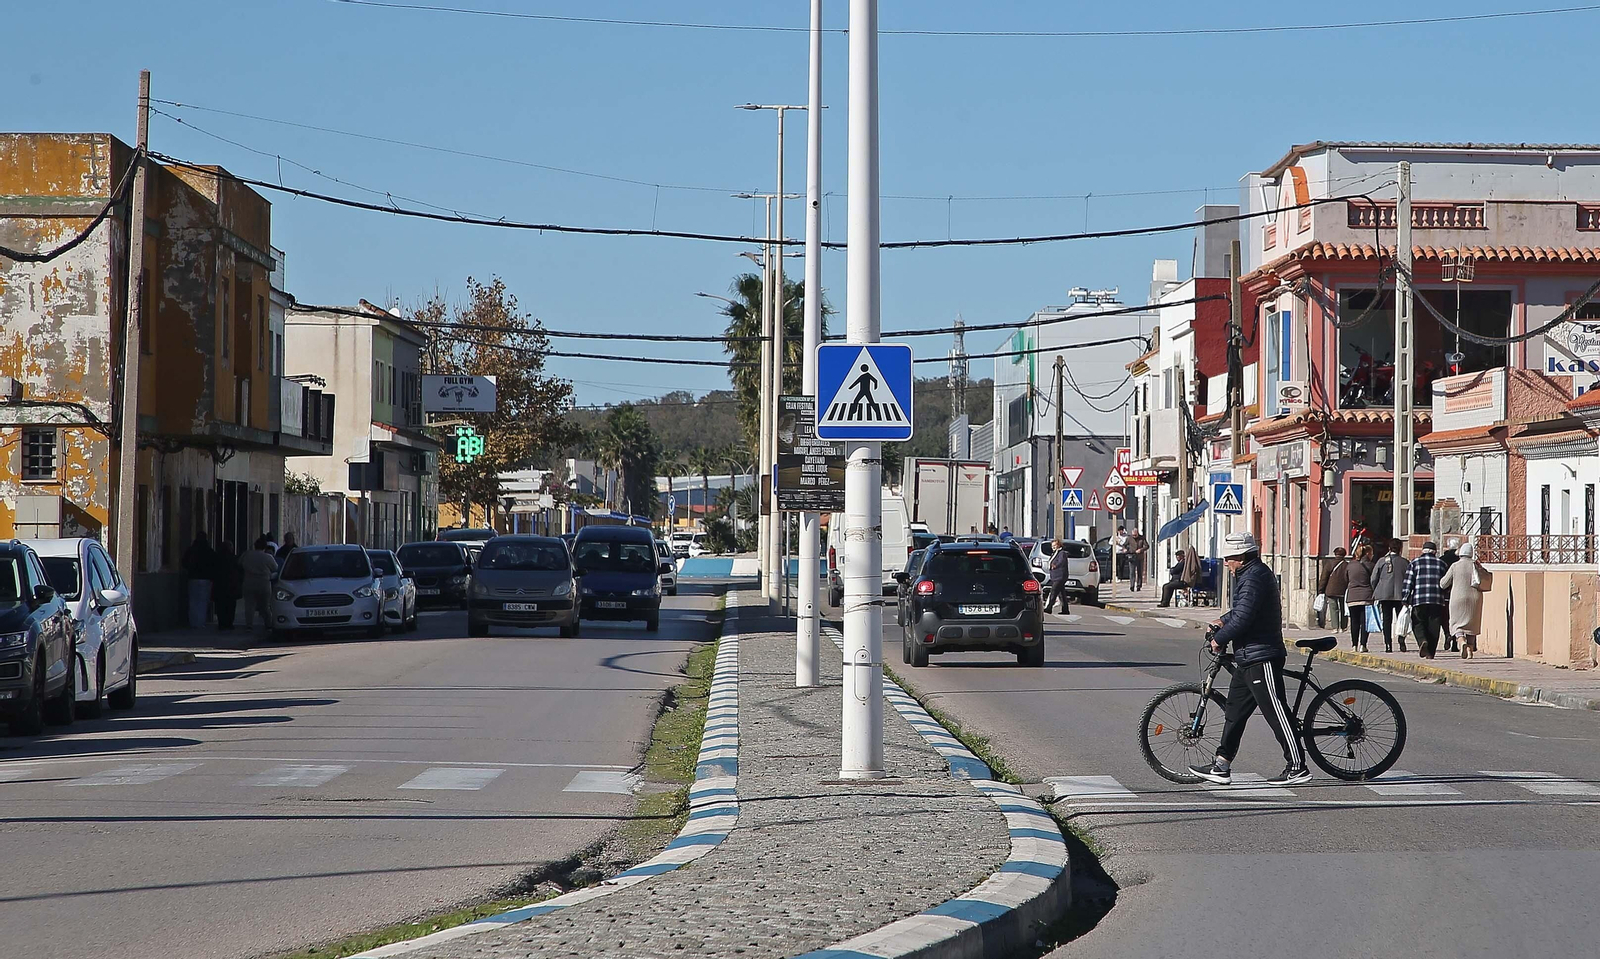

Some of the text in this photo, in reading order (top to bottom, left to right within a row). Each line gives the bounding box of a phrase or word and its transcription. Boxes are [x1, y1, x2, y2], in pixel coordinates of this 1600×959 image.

[444, 377, 474, 385] FULL GYM
[786, 402, 814, 410] GRAN FESTIVAL
[805, 456, 825, 464] CAYETANO
[802, 464, 828, 473] DANIEL LUQUE
[800, 477, 815, 486] MARCO
[1108, 496, 1123, 506] 30
